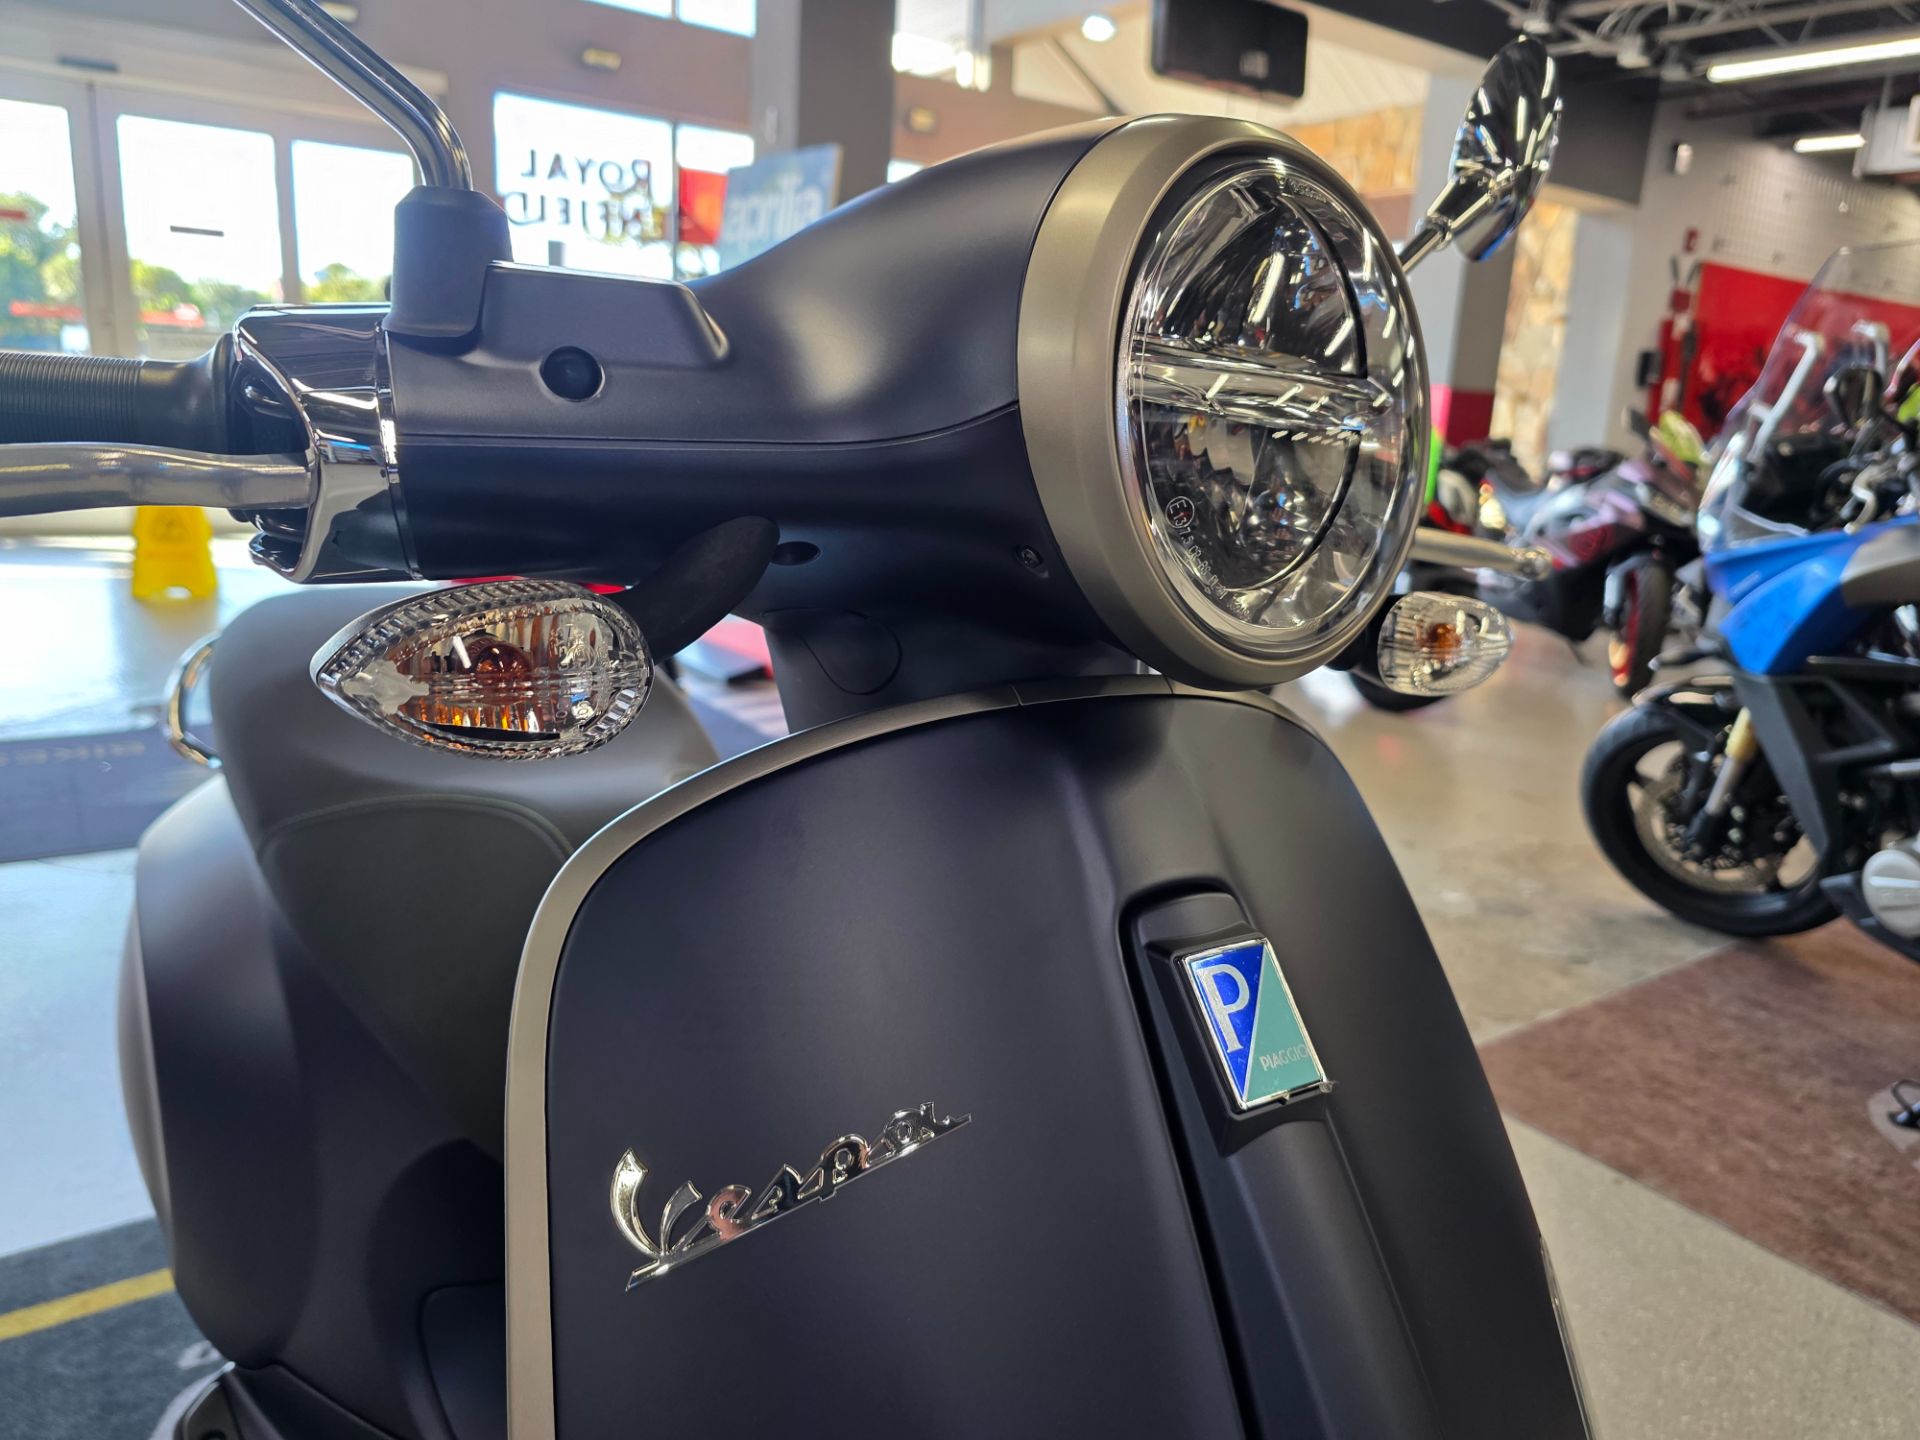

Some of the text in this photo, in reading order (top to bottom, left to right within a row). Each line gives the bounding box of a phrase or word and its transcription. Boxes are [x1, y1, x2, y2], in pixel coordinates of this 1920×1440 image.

[1197, 963, 1250, 1053] P
[1259, 1043, 1310, 1071] PIAGGIO
[610, 1101, 972, 1293] Vespa
